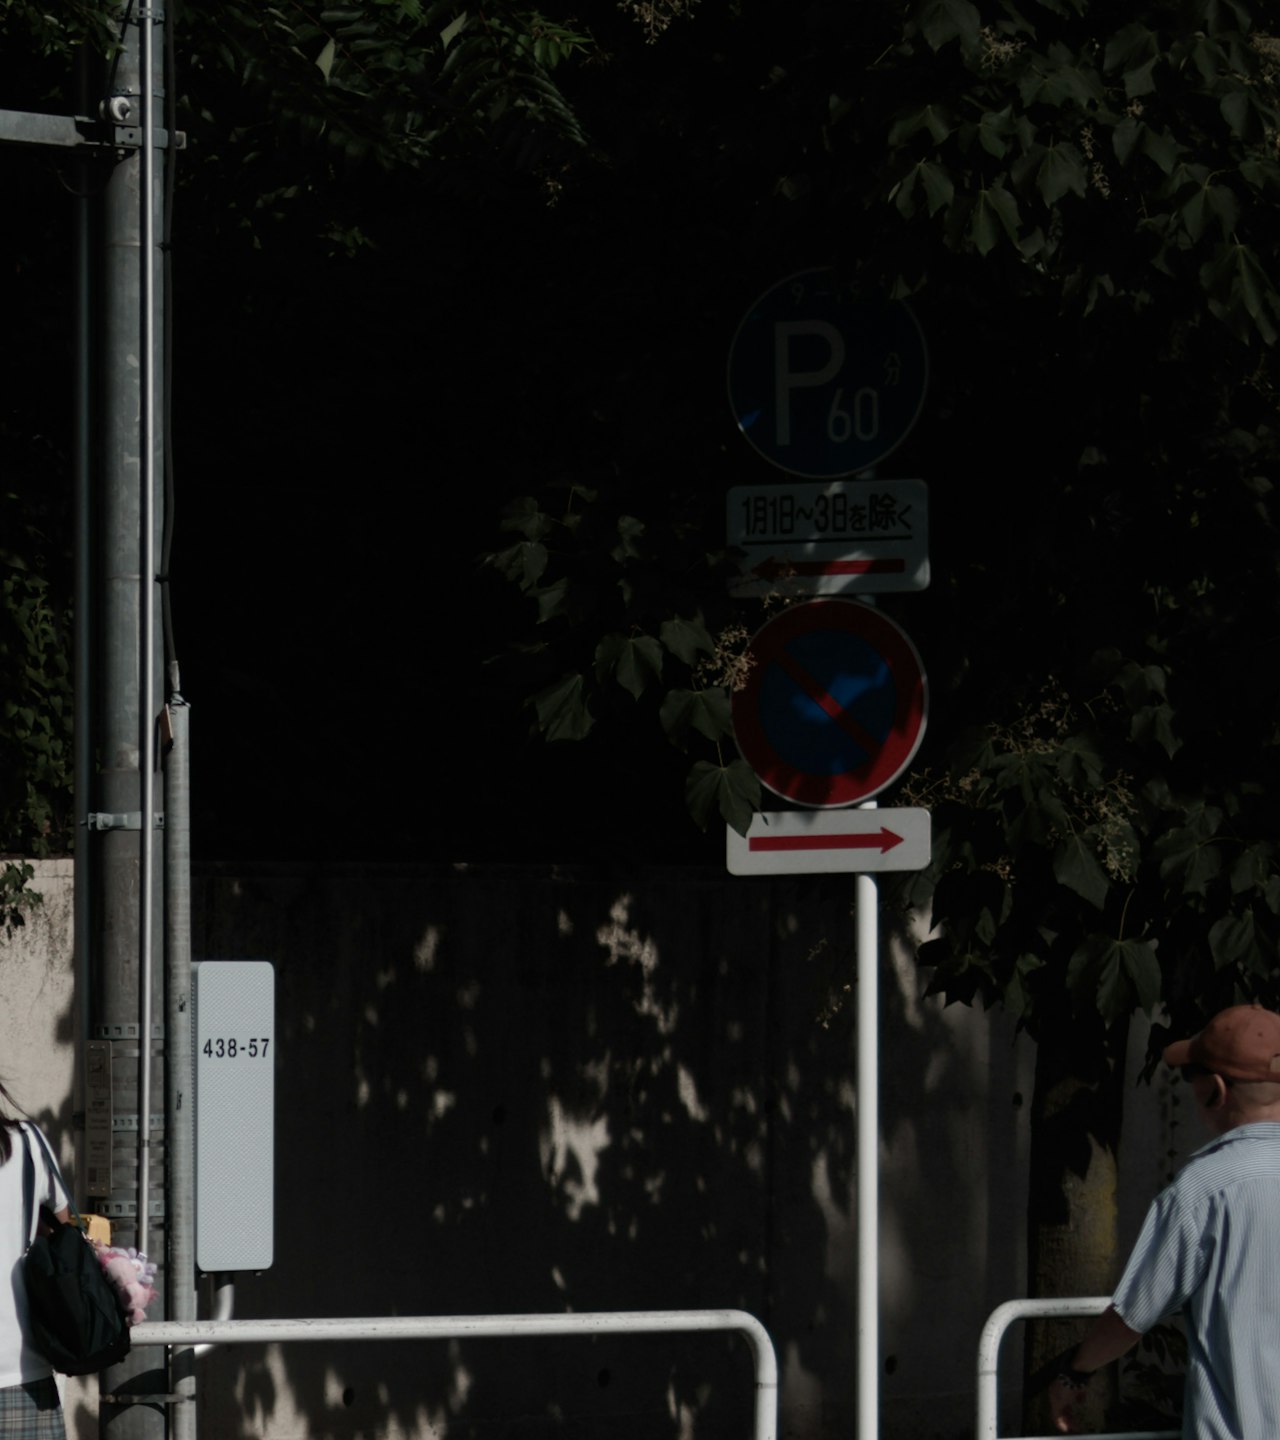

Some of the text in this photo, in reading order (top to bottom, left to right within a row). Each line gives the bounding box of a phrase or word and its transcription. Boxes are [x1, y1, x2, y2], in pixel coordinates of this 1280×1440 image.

[773, 319, 846, 447] P
[826, 351, 903, 443] 60 分
[203, 1038, 270, 1058] 438-57
